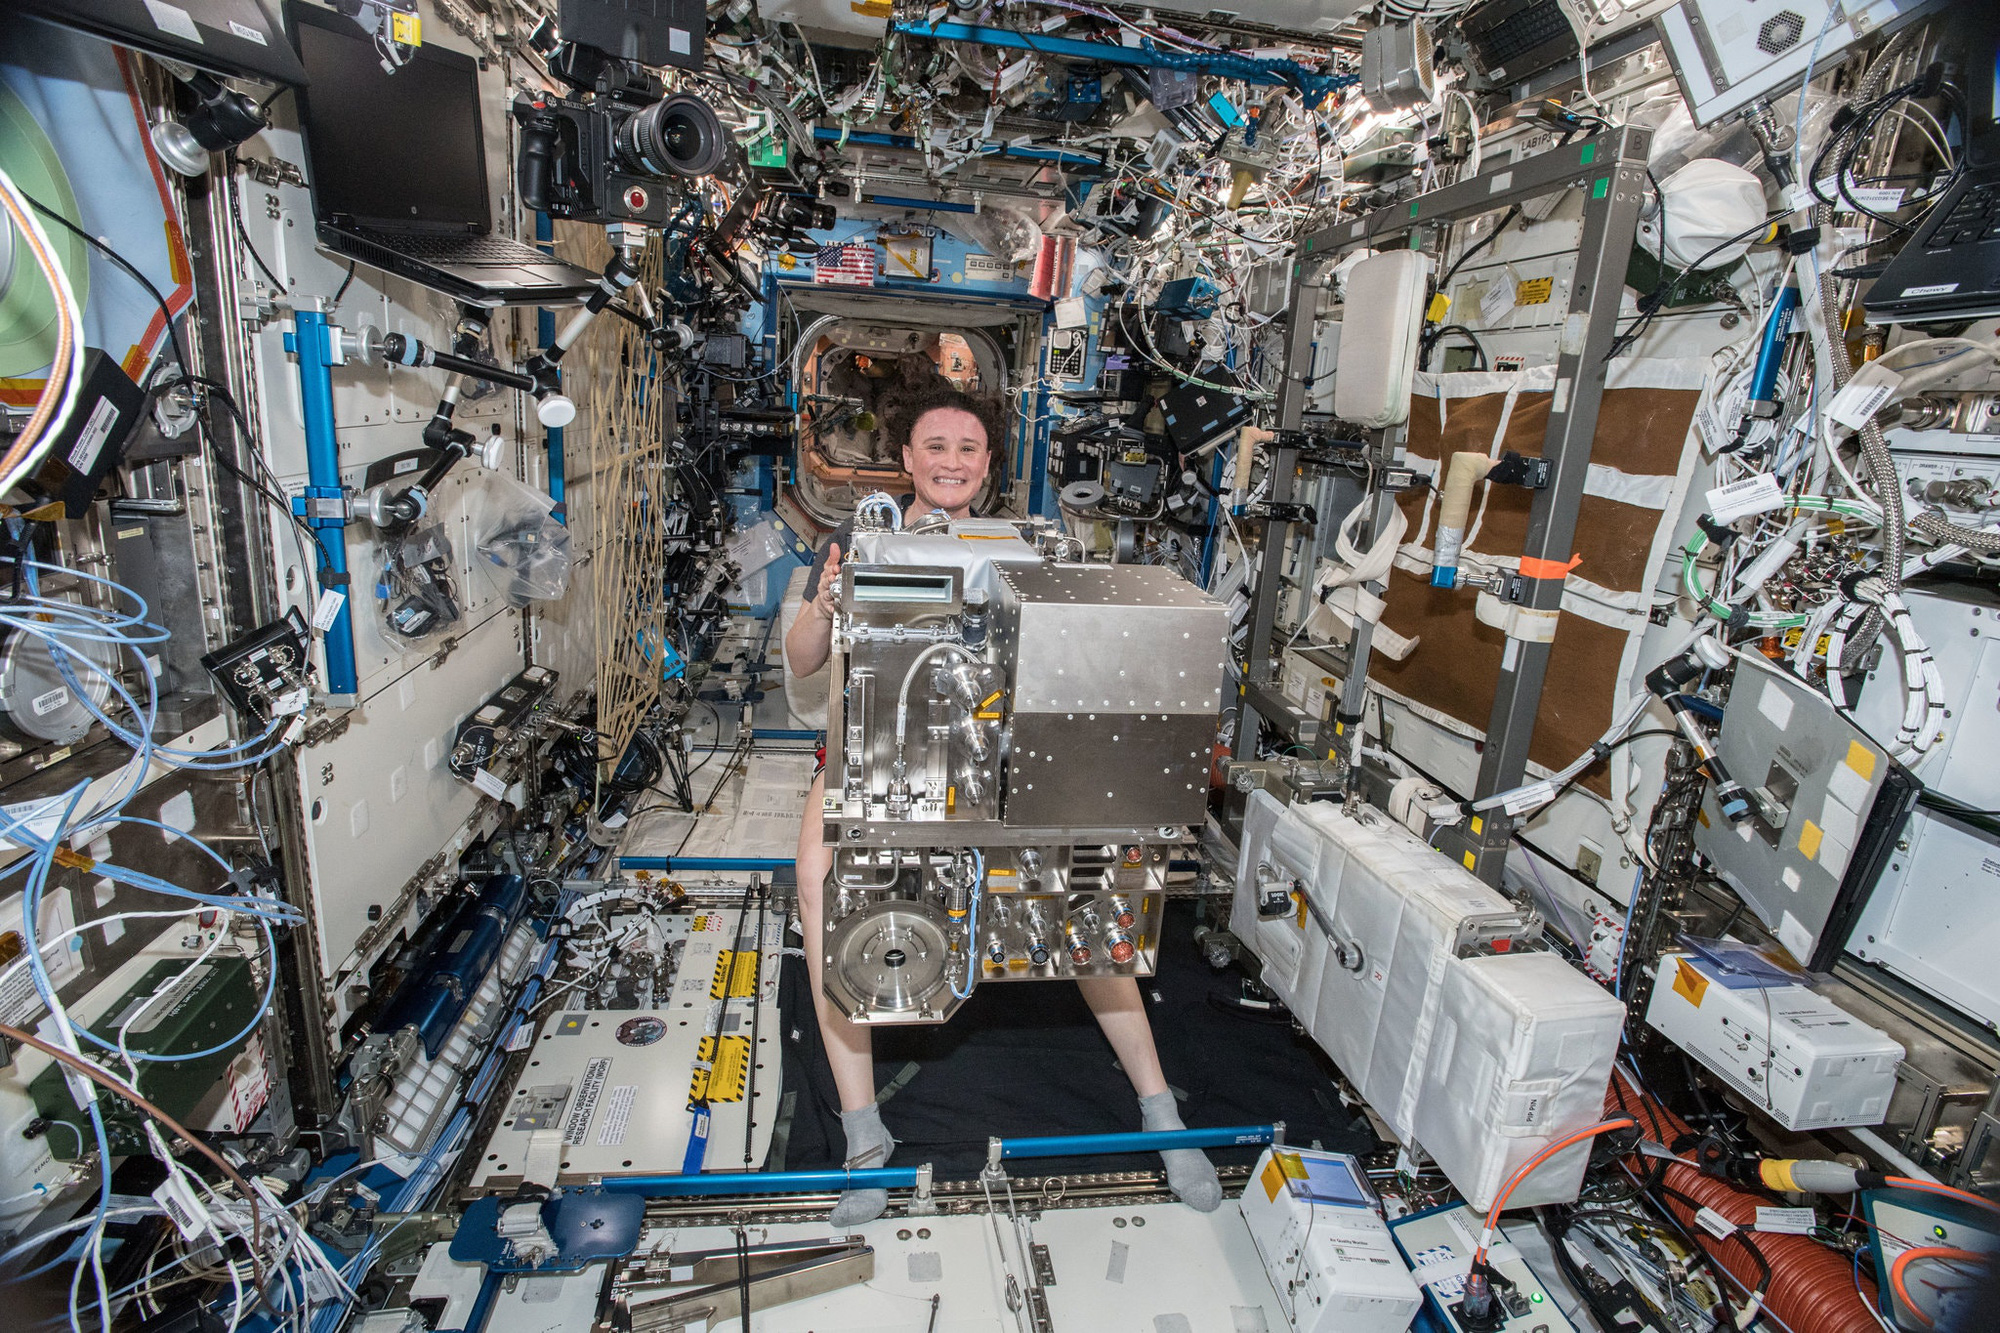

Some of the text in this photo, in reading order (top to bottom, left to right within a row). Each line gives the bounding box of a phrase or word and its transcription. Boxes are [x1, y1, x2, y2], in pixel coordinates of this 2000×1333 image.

[1521, 132, 1552, 151] LAB1P3
[1633, 135, 1642, 150] B
[1911, 286, 1947, 295] Chewy
[564, 1062, 599, 1142] WINDOW OBSERVATIONAL
[573, 1058, 611, 1146] RESEARCH FACILITY (WORF)
[34, 1155, 53, 1173] REMOT
